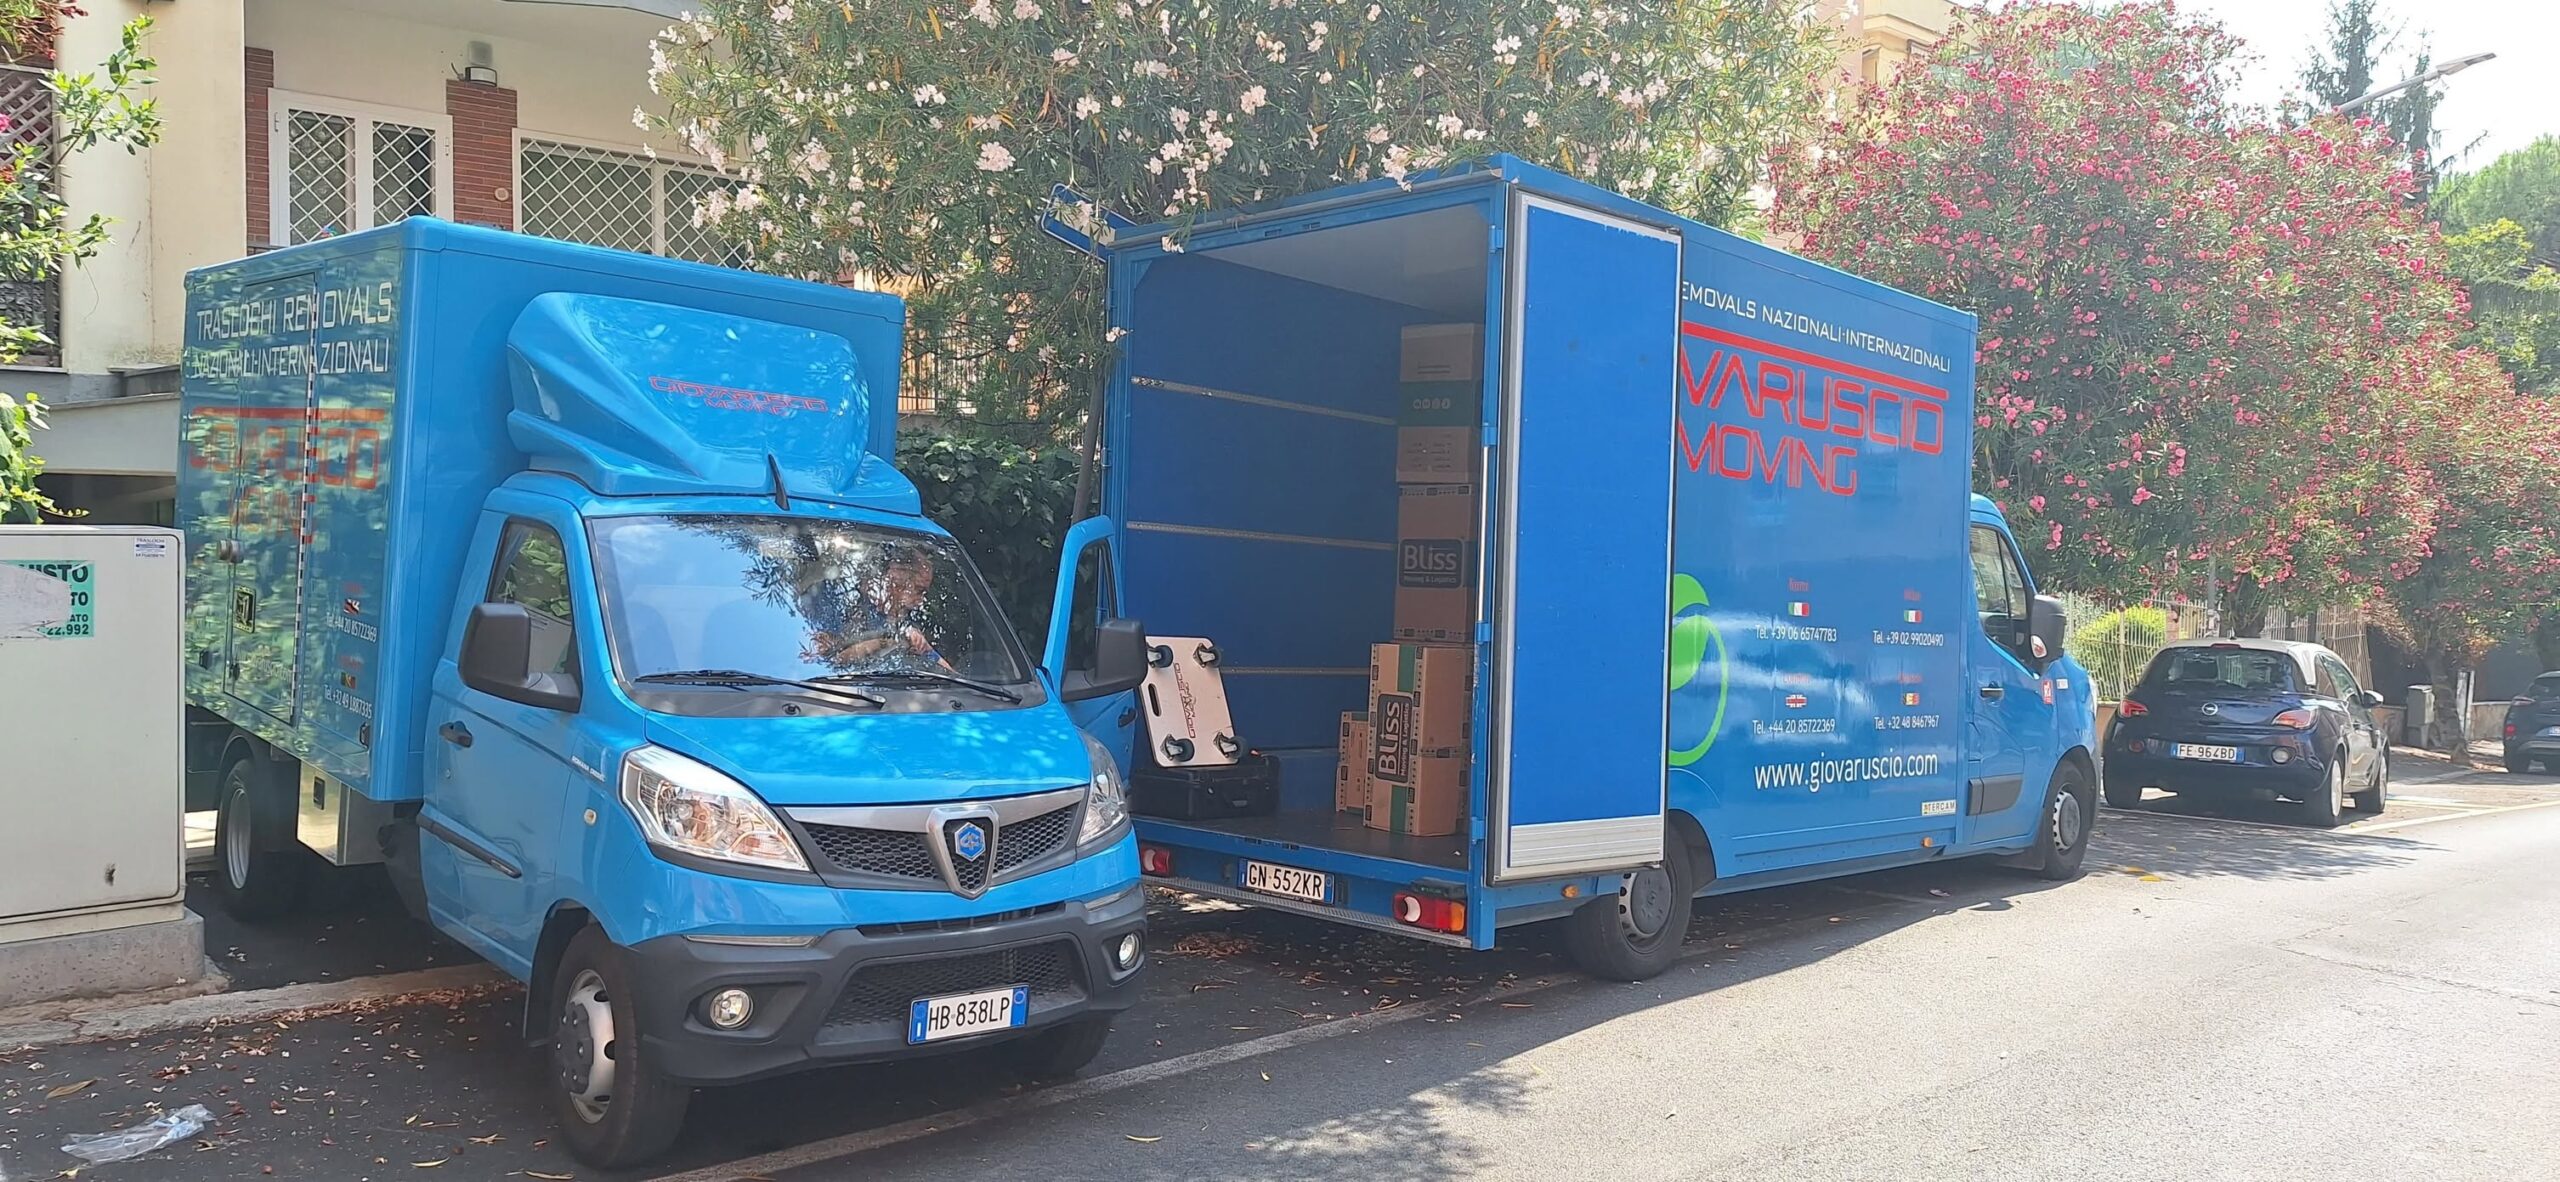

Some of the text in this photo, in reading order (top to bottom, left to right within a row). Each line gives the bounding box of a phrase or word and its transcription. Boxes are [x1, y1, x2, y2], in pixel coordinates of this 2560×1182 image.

[282, 281, 393, 334] REMOVALS
[1680, 344, 1945, 455] VARUSCIO
[1678, 417, 1858, 496] MOVING
[1772, 626, 1786, 640] +39
[1788, 626, 1799, 640] 06
[1800, 627, 1837, 642] 65747783
[1900, 632, 1909, 645] 02
[1910, 632, 1944, 646] 99020490
[1402, 702, 1410, 737] Logistics
[1752, 718, 1836, 734] Tel. +44 20 85722369
[1887, 716, 1900, 729] +32
[1378, 702, 1400, 775] Bliss
[2179, 744, 2235, 759] FE 964BD
[1400, 748, 1409, 776] Moving
[1754, 747, 1938, 793] www.giovaruscio.com
[1249, 864, 1267, 887] GN
[1272, 868, 1322, 898] 552KR
[928, 1005, 951, 1031] HB
[955, 997, 1010, 1026] 838LP
